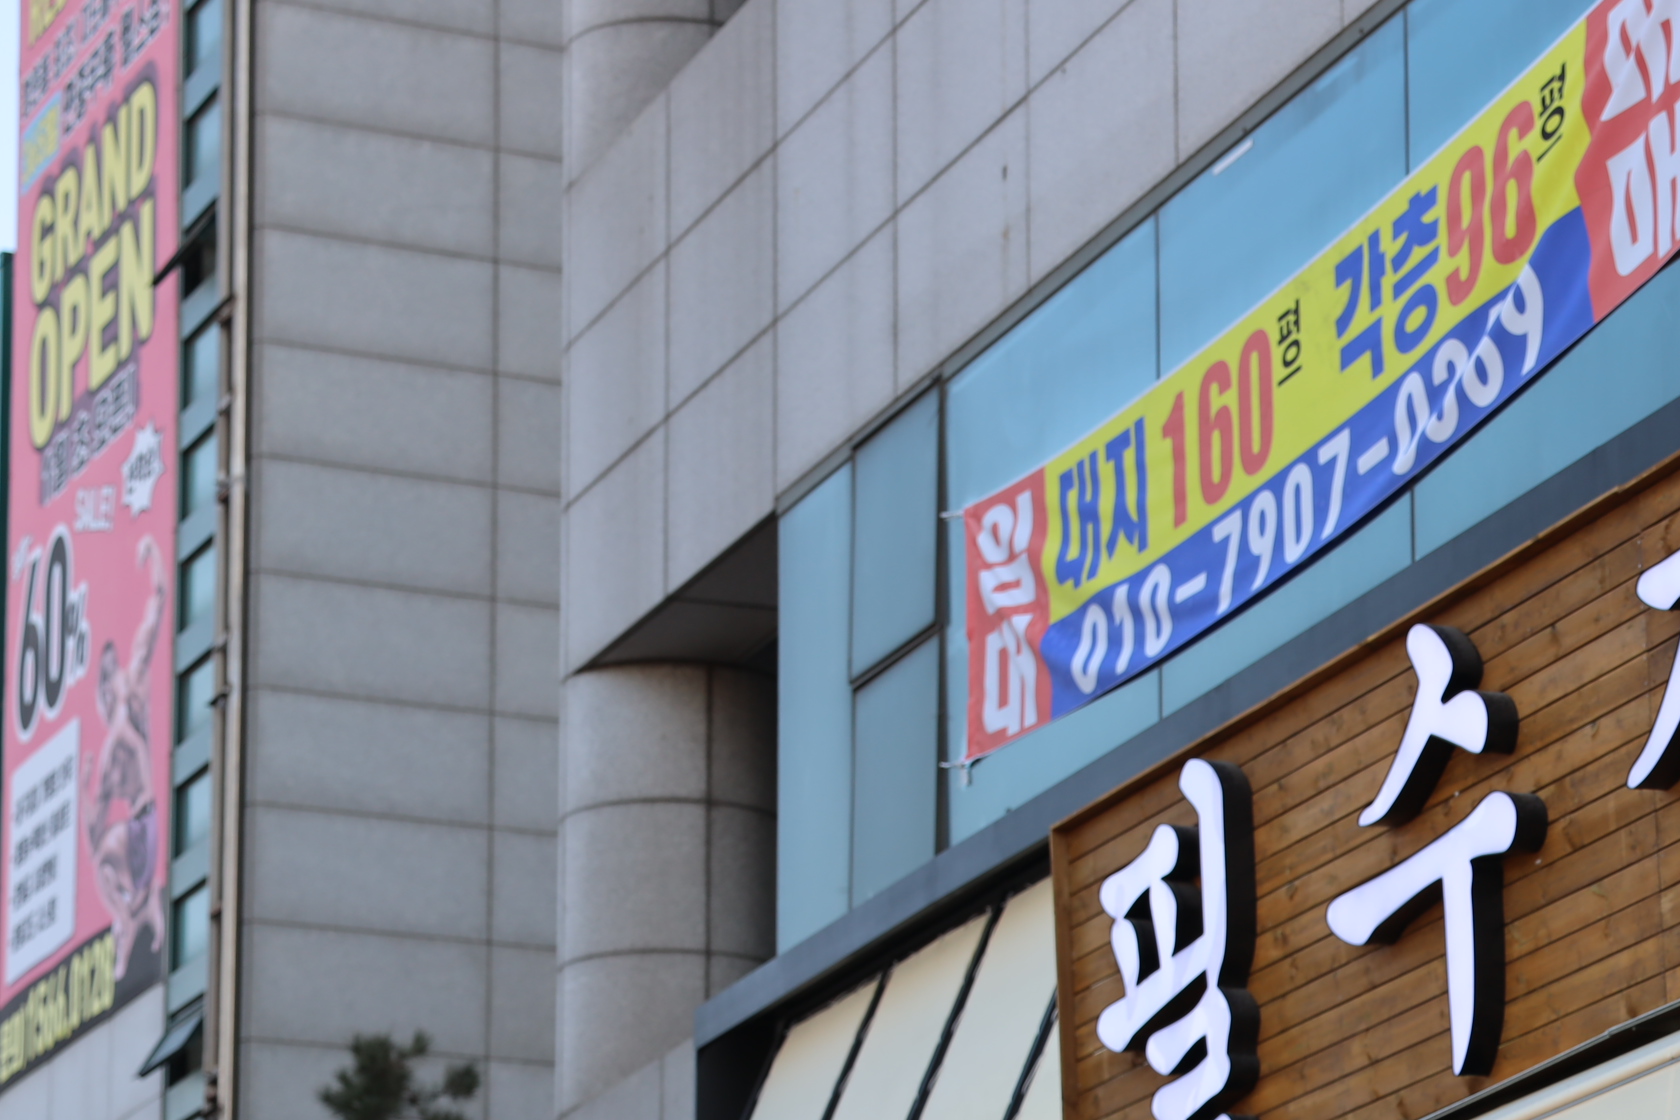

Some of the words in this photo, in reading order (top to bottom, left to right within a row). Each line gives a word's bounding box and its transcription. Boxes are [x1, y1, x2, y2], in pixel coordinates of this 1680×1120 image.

[31, 81, 156, 305] GRAND
[29, 198, 155, 451] OPEN
[1055, 416, 1149, 590] 대지
[1334, 184, 1441, 381] 각층
[976, 489, 1038, 737] 임대
